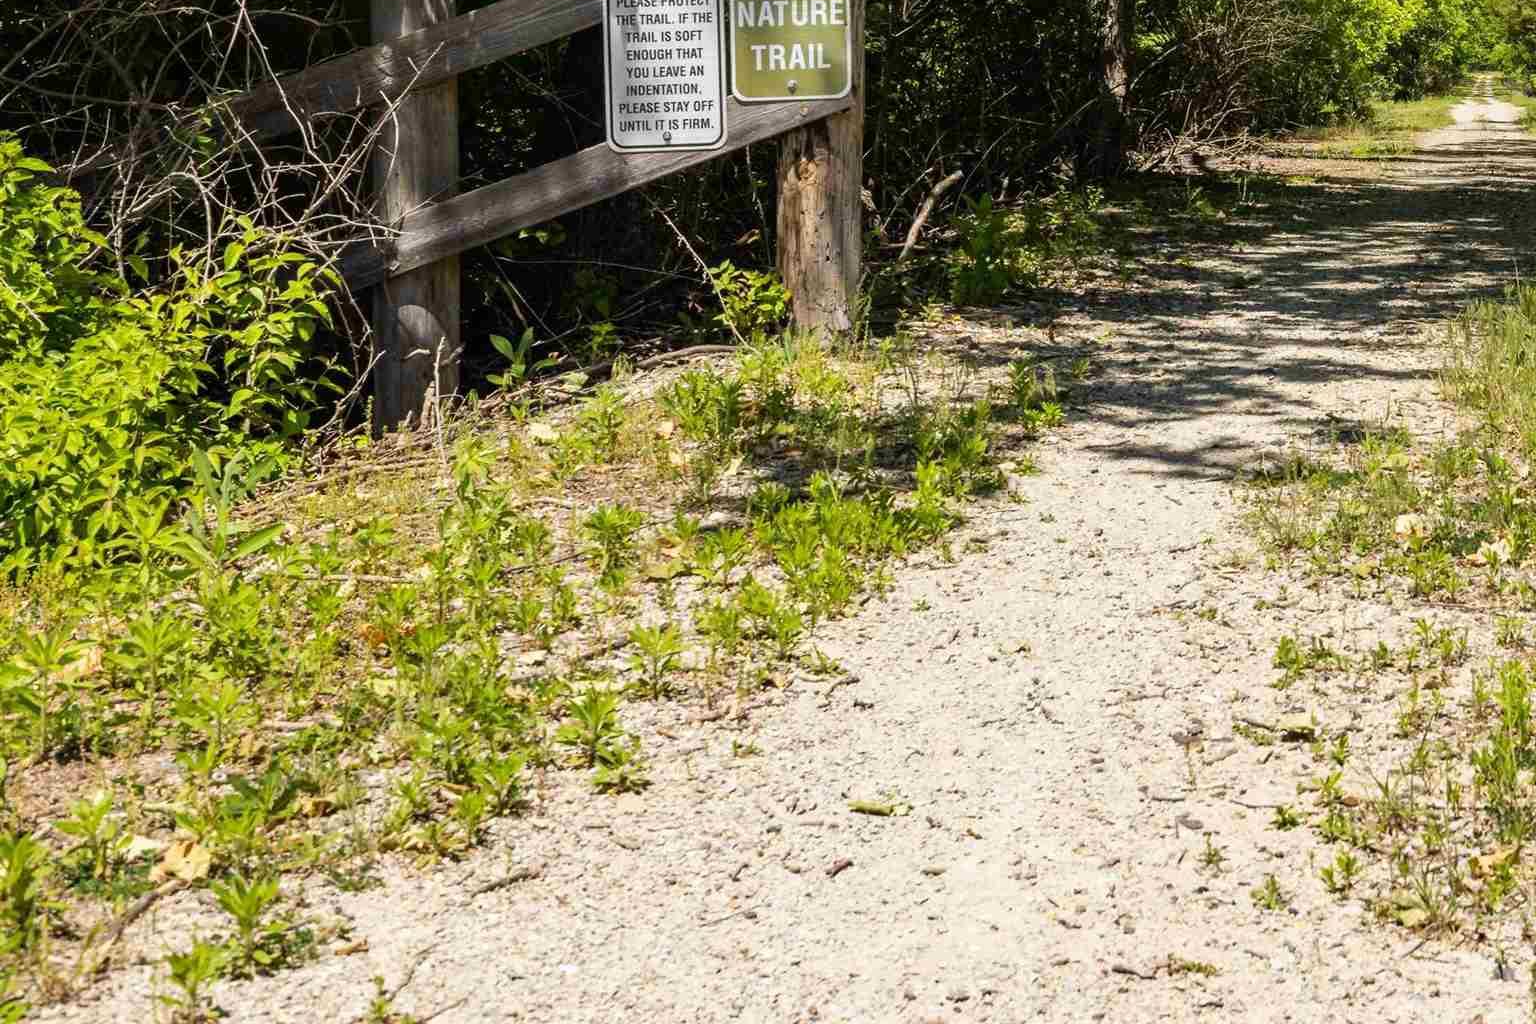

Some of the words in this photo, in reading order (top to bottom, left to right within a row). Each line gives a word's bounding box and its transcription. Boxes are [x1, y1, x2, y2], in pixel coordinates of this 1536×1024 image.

[616, 15, 638, 26] THE
[640, 14, 674, 25] TRAIL.
[678, 13, 690, 23] IF
[693, 12, 712, 23] THE
[737, 0, 845, 27] NATURE
[626, 32, 657, 43] TRAIL
[661, 31, 671, 41] IS
[675, 31, 702, 41] SOFT
[626, 49, 672, 61] ENOUGH
[677, 48, 703, 59] THAT
[751, 44, 831, 70] TRAIL
[627, 67, 649, 78] YOU
[653, 66, 686, 77] LEAVE
[690, 65, 704, 76] AN
[619, 102, 661, 114] PLEASE
[664, 101, 690, 113] STAY
[694, 101, 714, 112] OFF
[620, 120, 652, 132] UNTIL
[656, 120, 664, 130] IT
[668, 119, 679, 130] IS
[682, 119, 714, 130] FIRM.
